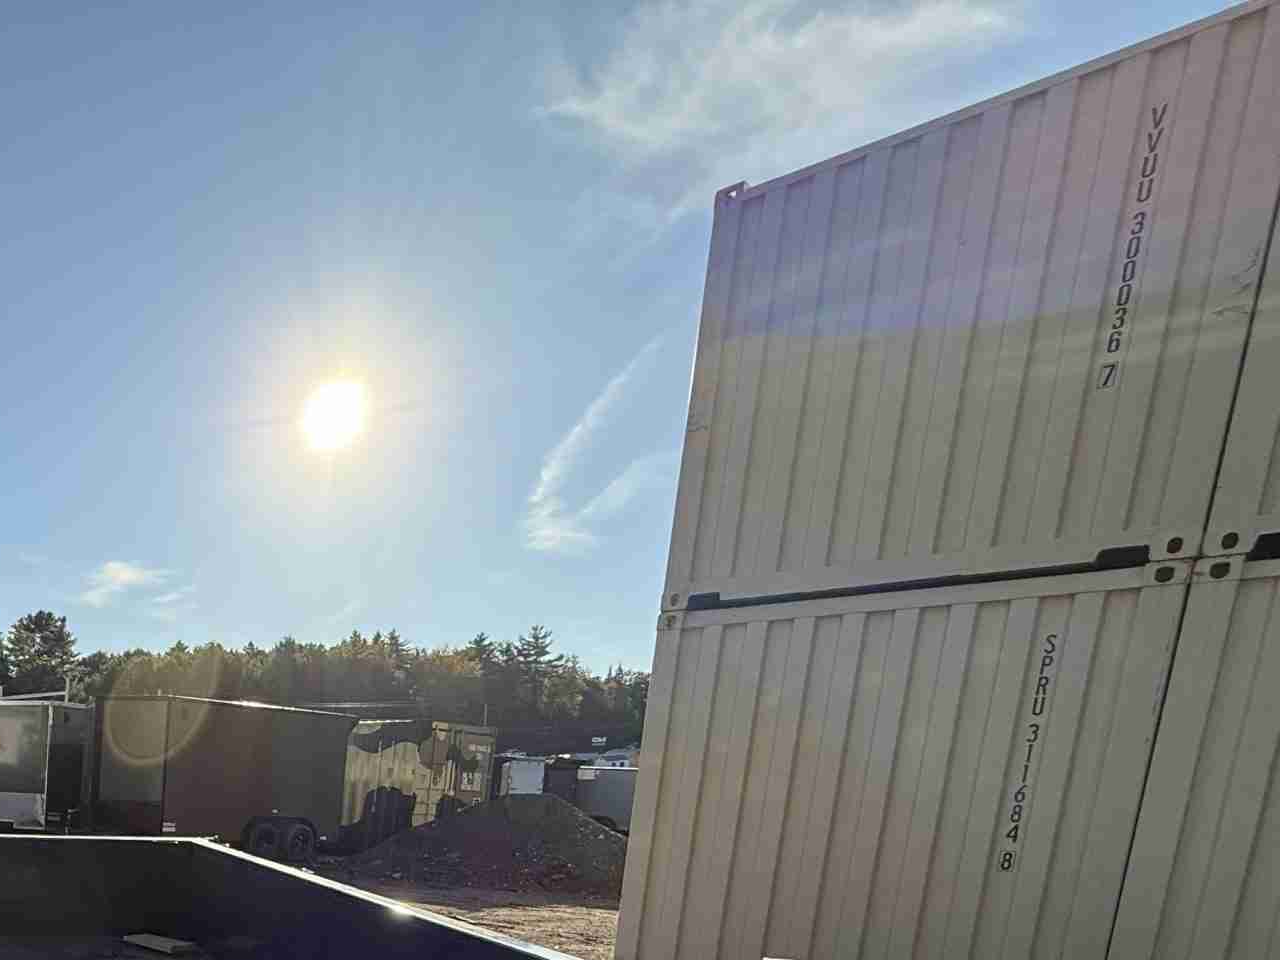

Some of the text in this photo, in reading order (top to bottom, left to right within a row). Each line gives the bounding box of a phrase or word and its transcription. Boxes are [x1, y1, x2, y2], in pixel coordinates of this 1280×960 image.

[1102, 103, 1168, 387] VVUU 300036 7
[999, 633, 1057, 871] SPRU 311684 8
